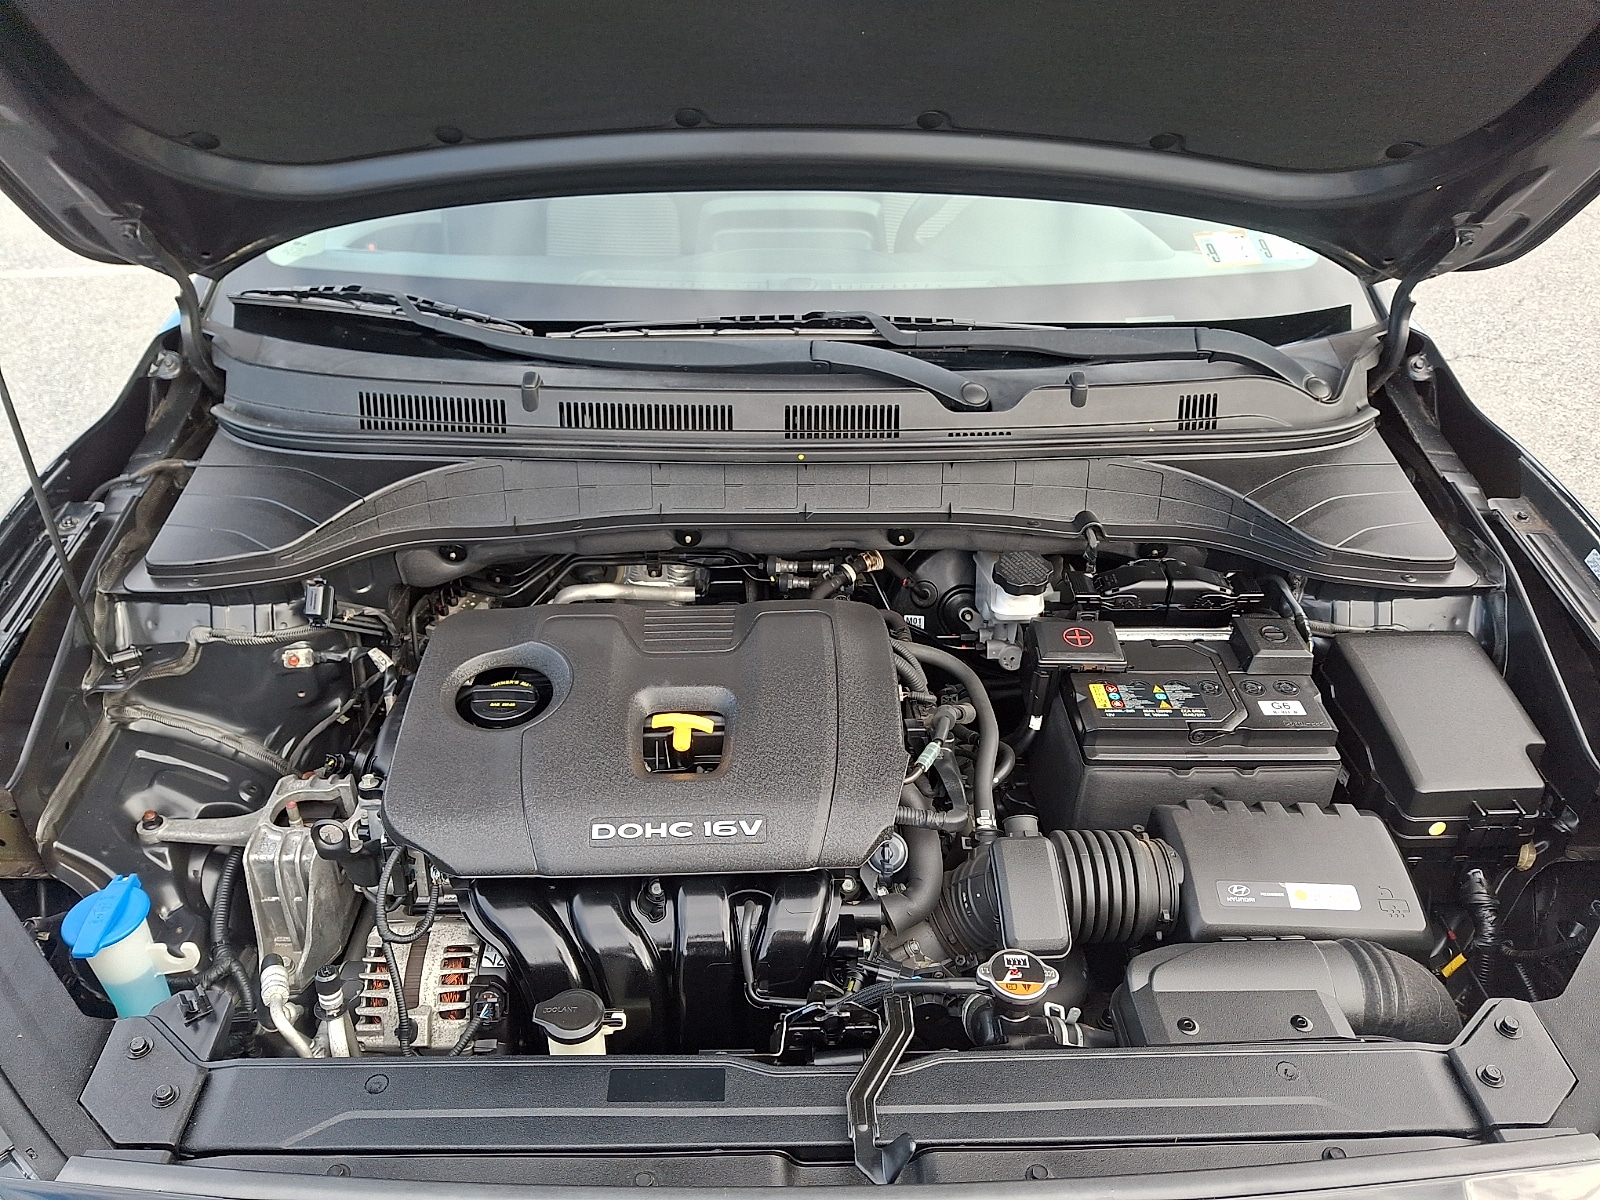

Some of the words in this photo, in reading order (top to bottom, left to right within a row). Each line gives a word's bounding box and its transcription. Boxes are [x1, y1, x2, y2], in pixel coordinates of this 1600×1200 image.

[1271, 701, 1291, 710] G6
[591, 821, 694, 840] DOHC
[703, 819, 763, 838] 16V
